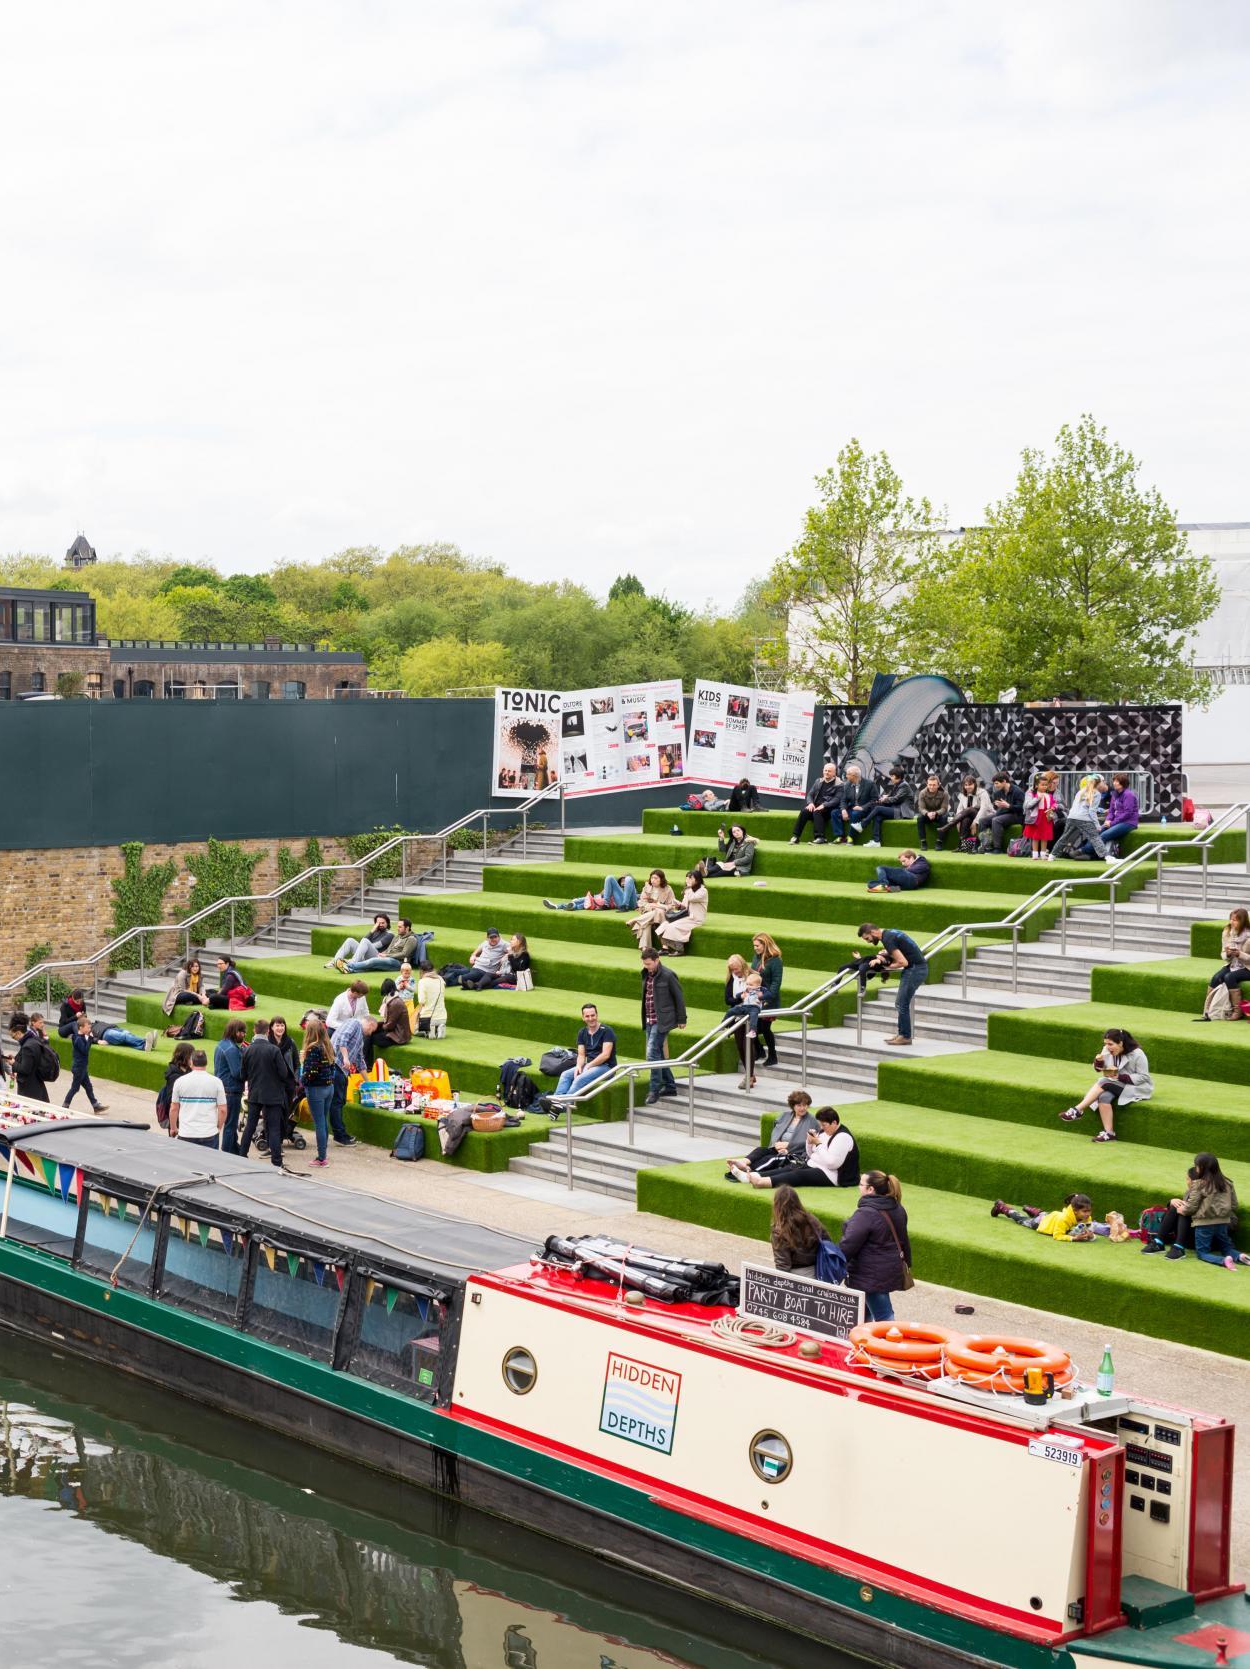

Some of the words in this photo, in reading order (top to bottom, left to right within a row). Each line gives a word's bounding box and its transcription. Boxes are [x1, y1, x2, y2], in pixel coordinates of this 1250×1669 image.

[501, 690, 561, 714] TONIC
[626, 696, 646, 704] MUSIC
[698, 689, 722, 703] KIDS
[782, 754, 805, 764] LIVING
[746, 1268, 770, 1283] hidden
[773, 1277, 794, 1289] depths
[797, 1284, 814, 1294] canal
[746, 1303, 769, 1317] 0745
[772, 1312, 788, 1322] 608
[790, 1315, 811, 1329] 4584
[748, 1282, 778, 1305] PARTY
[784, 1294, 809, 1313] BOAT
[829, 1305, 854, 1325] HIRE
[612, 1360, 675, 1395] HIDDEN
[607, 1411, 666, 1445] DEPTHS
[1044, 1445, 1078, 1465] 523919
